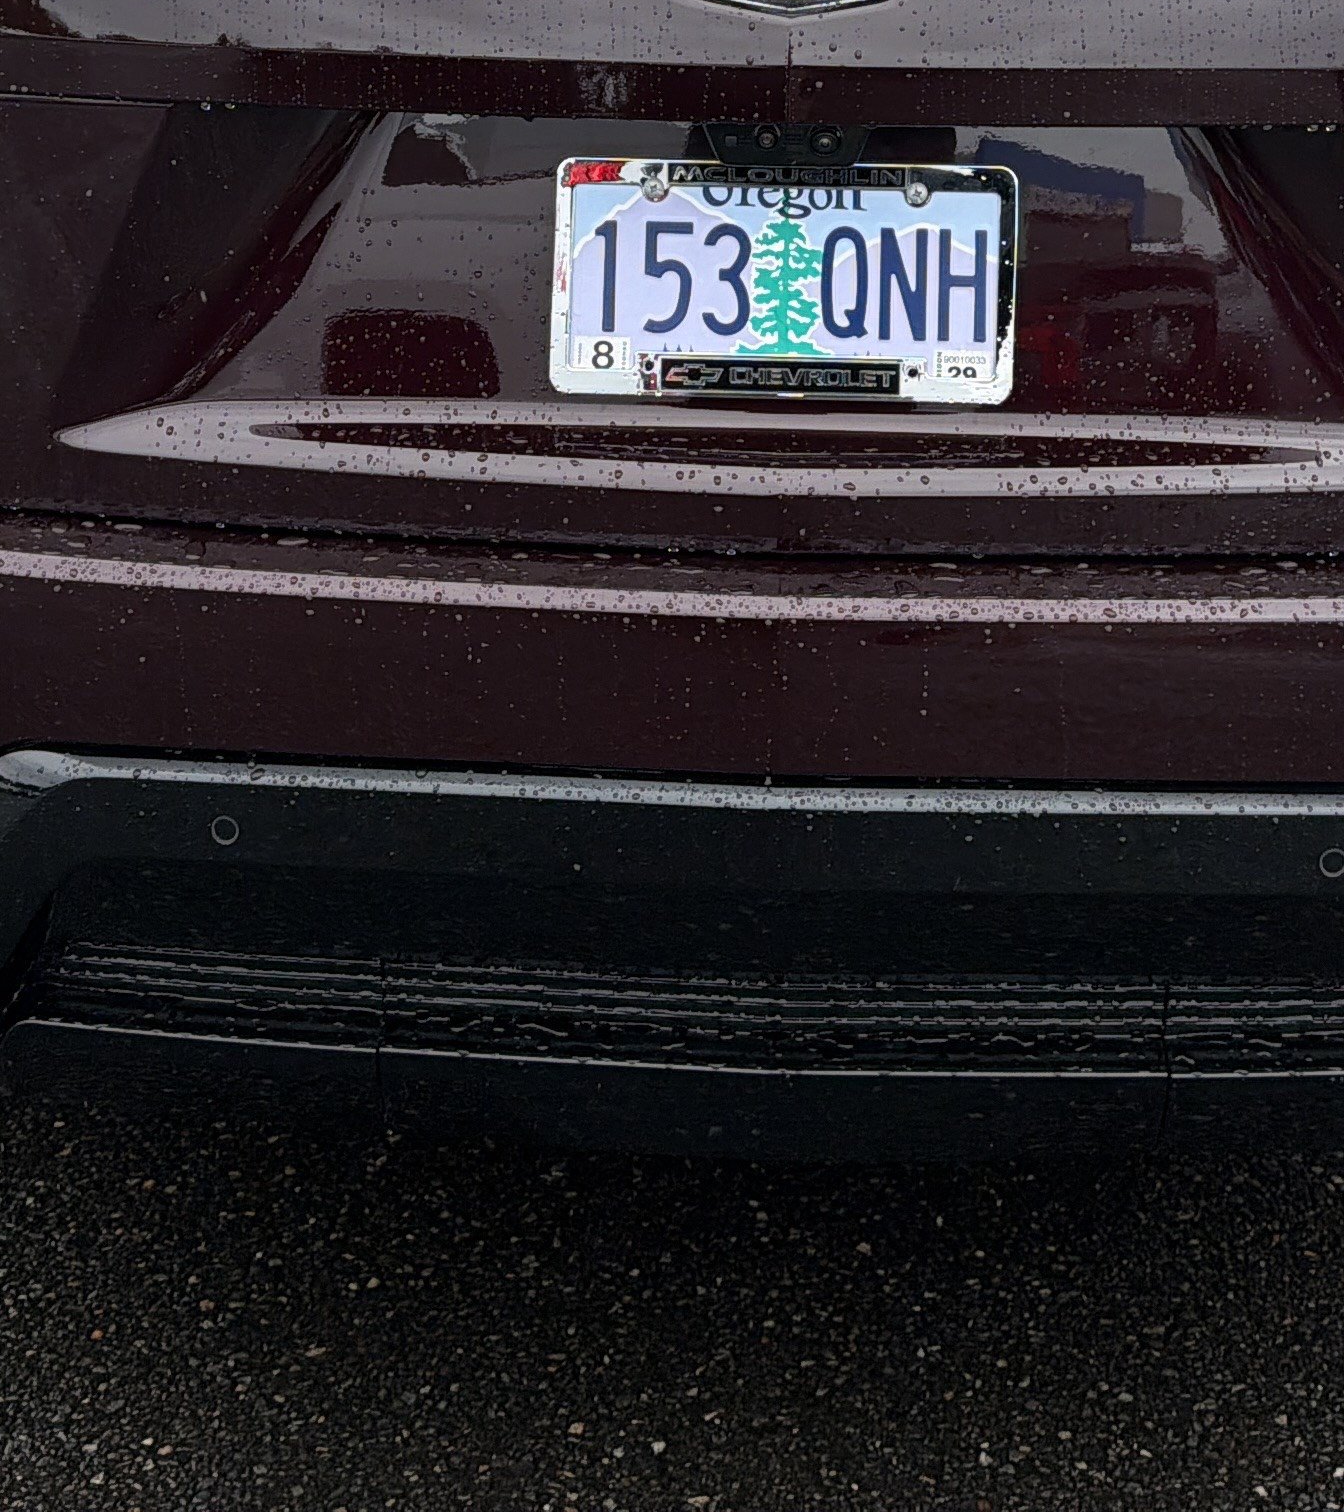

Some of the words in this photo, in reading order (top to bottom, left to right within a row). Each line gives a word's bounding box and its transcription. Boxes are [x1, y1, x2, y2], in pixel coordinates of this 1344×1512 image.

[671, 164, 904, 186] MCLOUGHLIN
[594, 219, 752, 335] 153
[820, 225, 989, 344] QNH
[592, 340, 615, 370] 8
[728, 366, 897, 388] CHEVROLET
